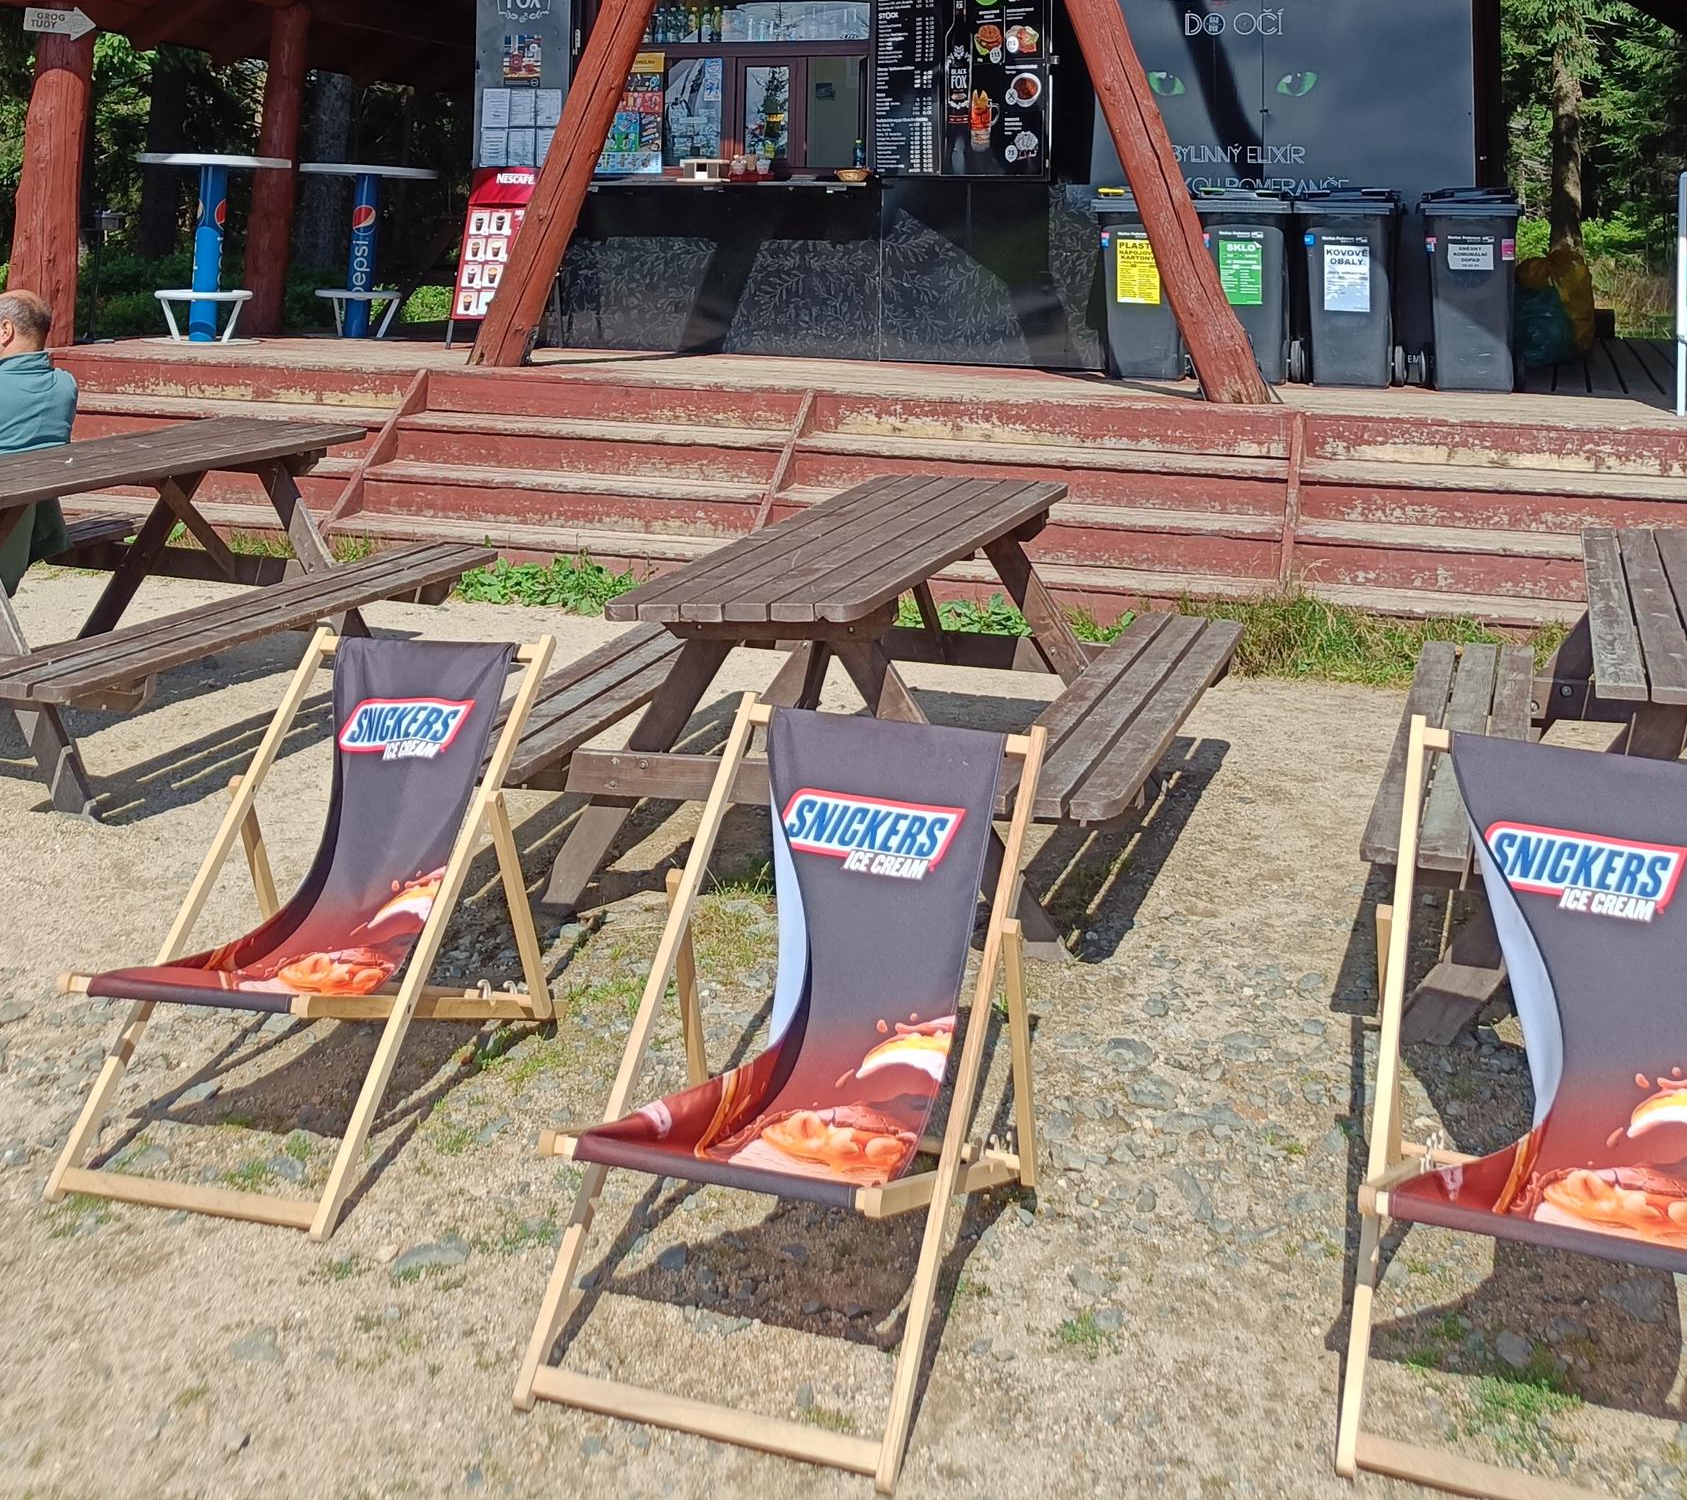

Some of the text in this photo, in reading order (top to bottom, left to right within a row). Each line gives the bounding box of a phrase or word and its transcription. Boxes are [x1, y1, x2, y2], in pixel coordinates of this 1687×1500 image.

[31, 19, 57, 28] TUDY
[37, 12, 65, 21] GROG
[878, 11, 899, 19] STOCK
[1233, 8, 1284, 36] OČÍ
[951, 75, 967, 89] FOX
[1247, 143, 1306, 164] ELIXÍR
[496, 173, 535, 185] NESCAFÉ
[1226, 243, 1256, 251] SKLO
[1326, 247, 1368, 257] KOVOVÉ
[1330, 257, 1364, 266] OBALY
[346, 705, 460, 743] SNICKERS
[382, 739, 440, 760] ICE CREAM
[787, 799, 949, 857] SNICKERS
[843, 850, 928, 879] ICE CREAM
[1494, 832, 1672, 898] SNICKERS
[1559, 887, 1656, 922] ICE CREAM
